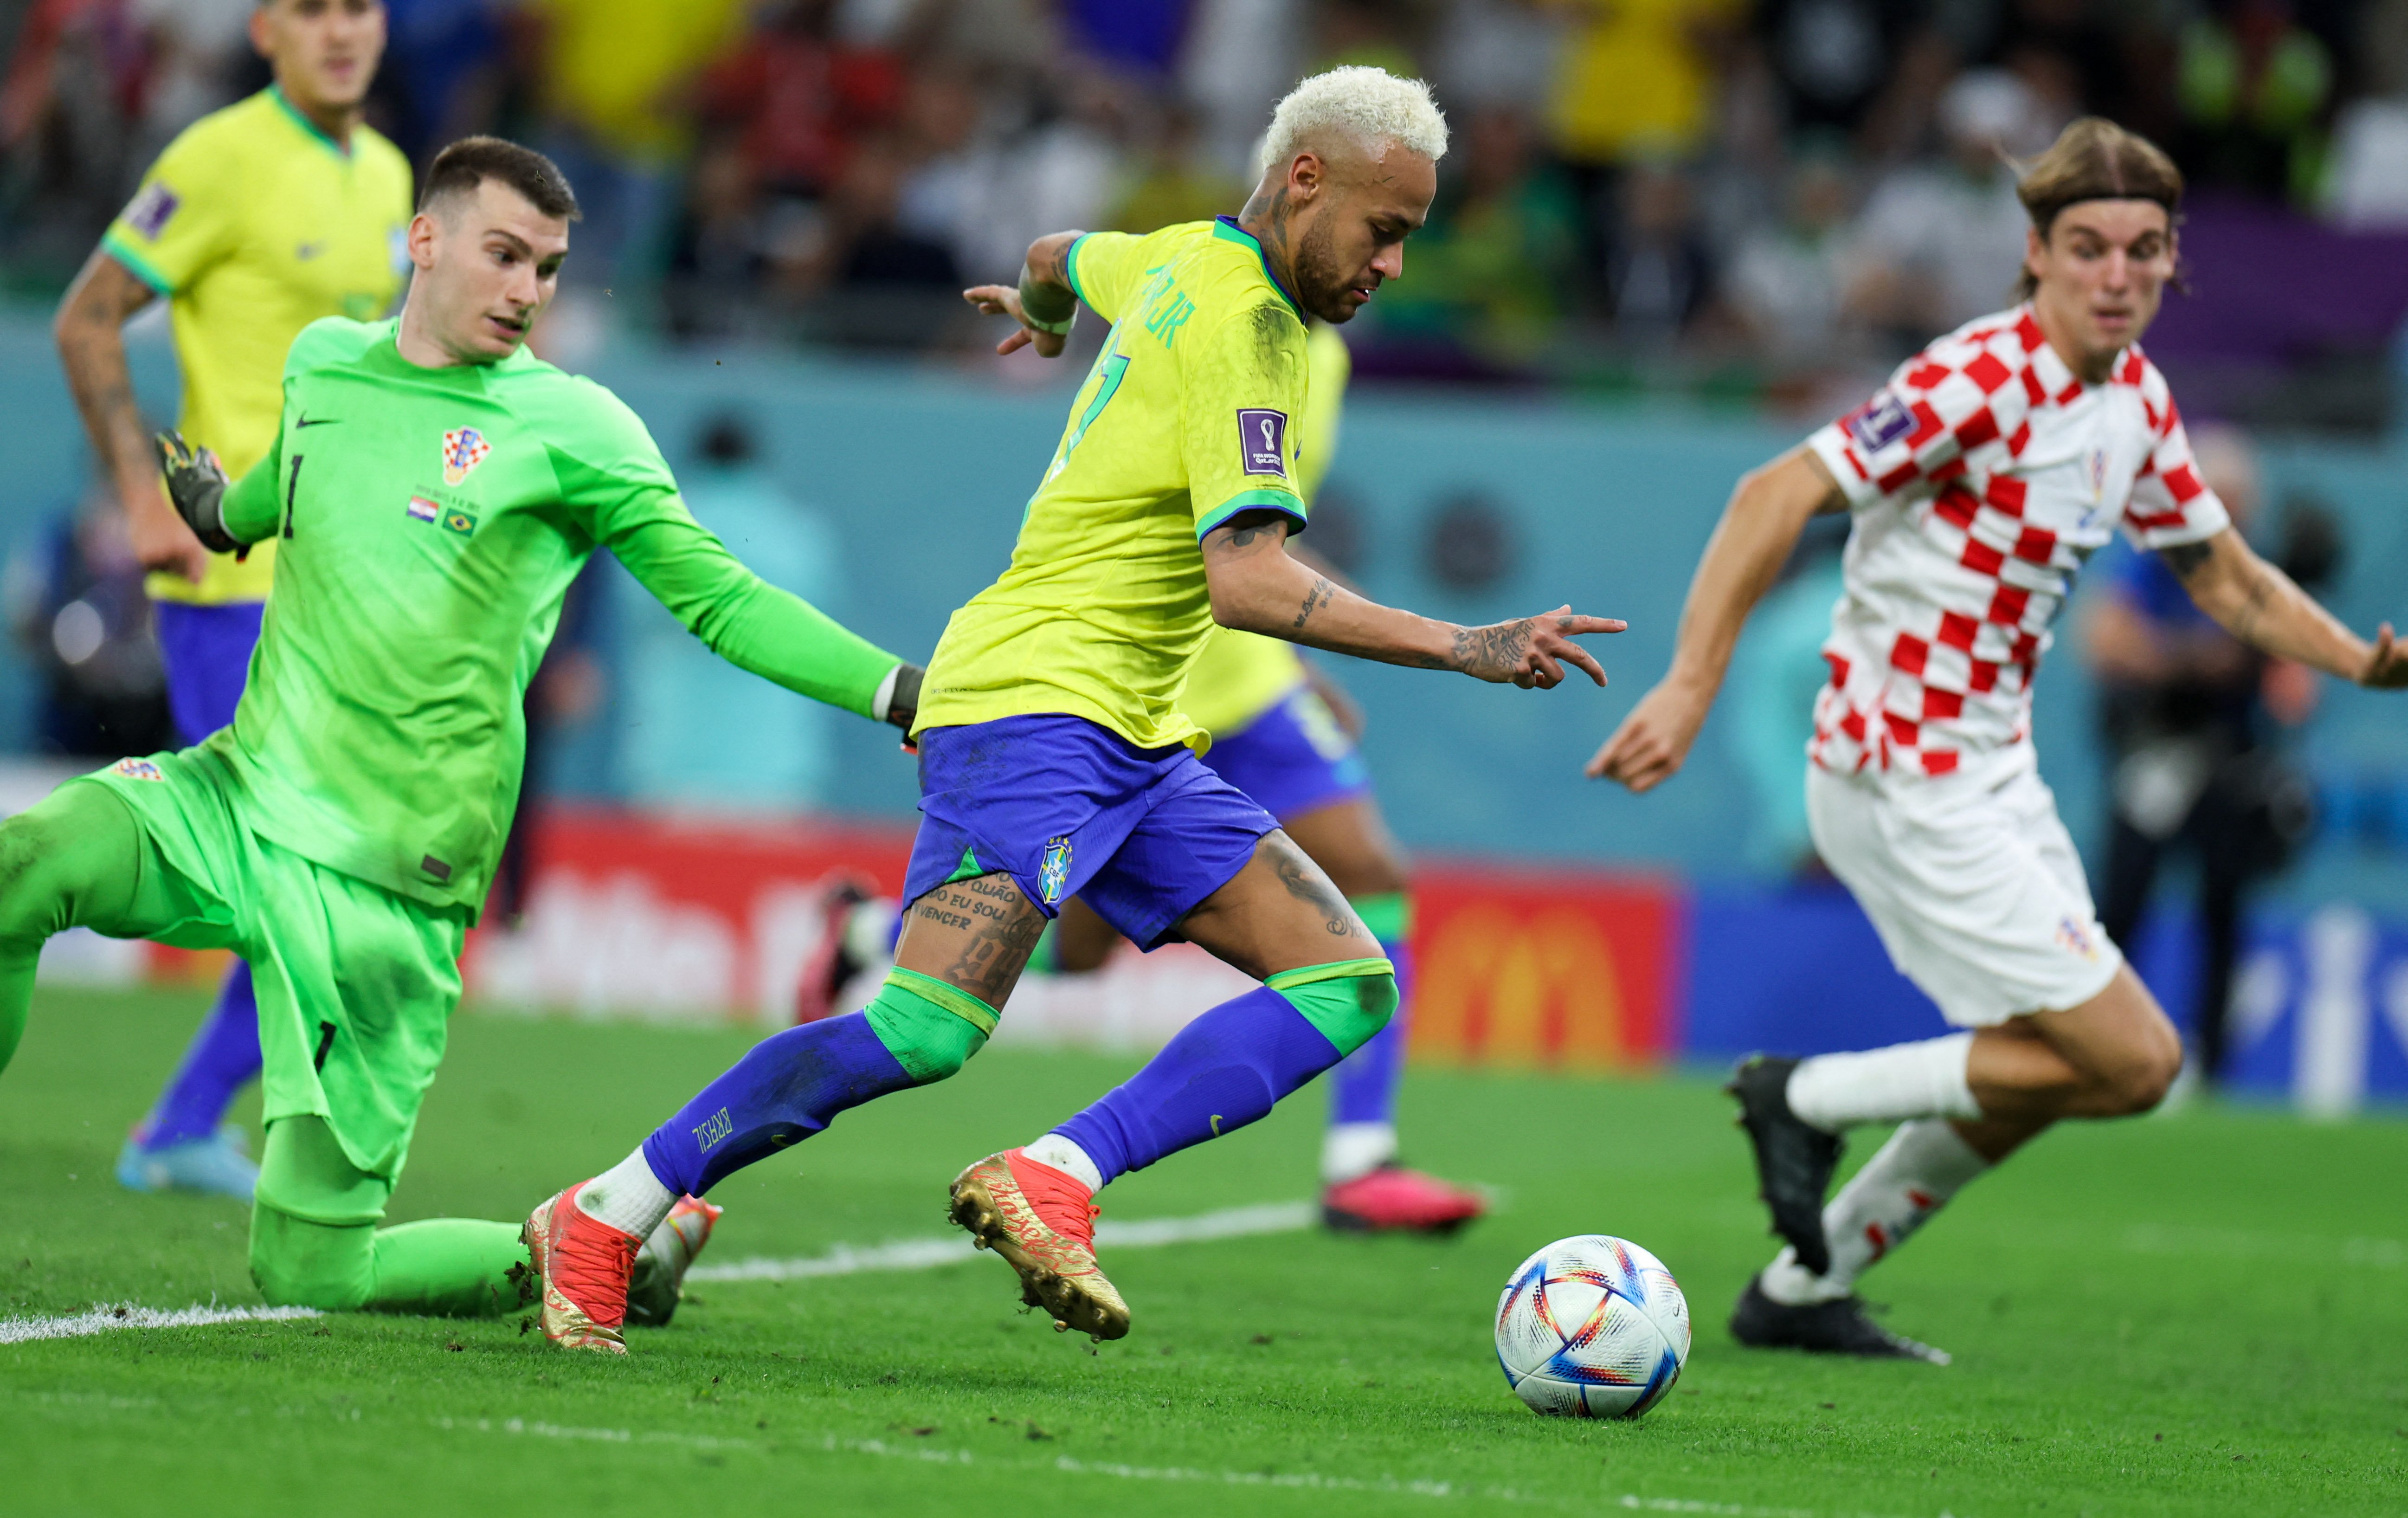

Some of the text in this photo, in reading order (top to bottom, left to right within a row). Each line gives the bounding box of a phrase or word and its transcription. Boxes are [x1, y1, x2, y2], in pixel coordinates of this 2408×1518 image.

[283, 455, 304, 539] 1
[1049, 867, 1060, 878] CBF
[971, 880, 1016, 903] QUÃO
[949, 894, 972, 909] EU
[972, 901, 1007, 921] SOU
[691, 1106, 733, 1155] BRASIL
